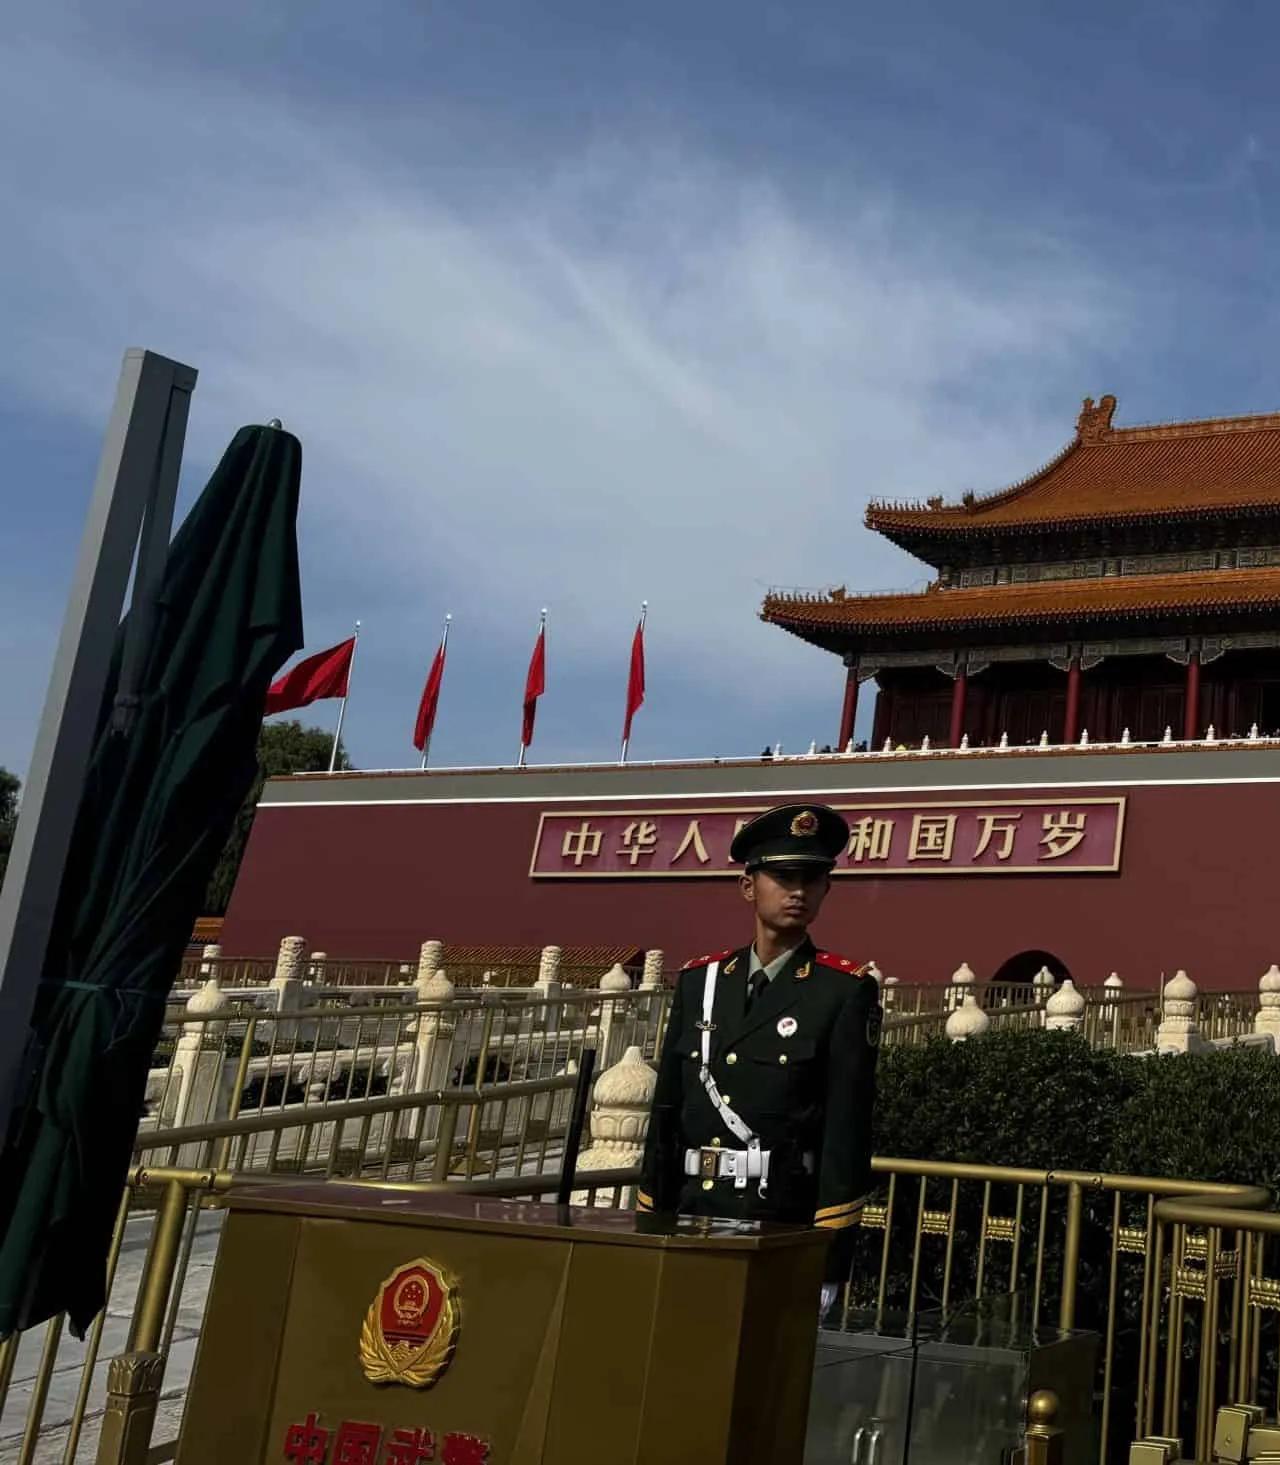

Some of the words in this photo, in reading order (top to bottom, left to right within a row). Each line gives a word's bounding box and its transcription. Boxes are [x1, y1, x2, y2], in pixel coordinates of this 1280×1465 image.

[561, 811, 1088, 865] 中华人和国万岁
